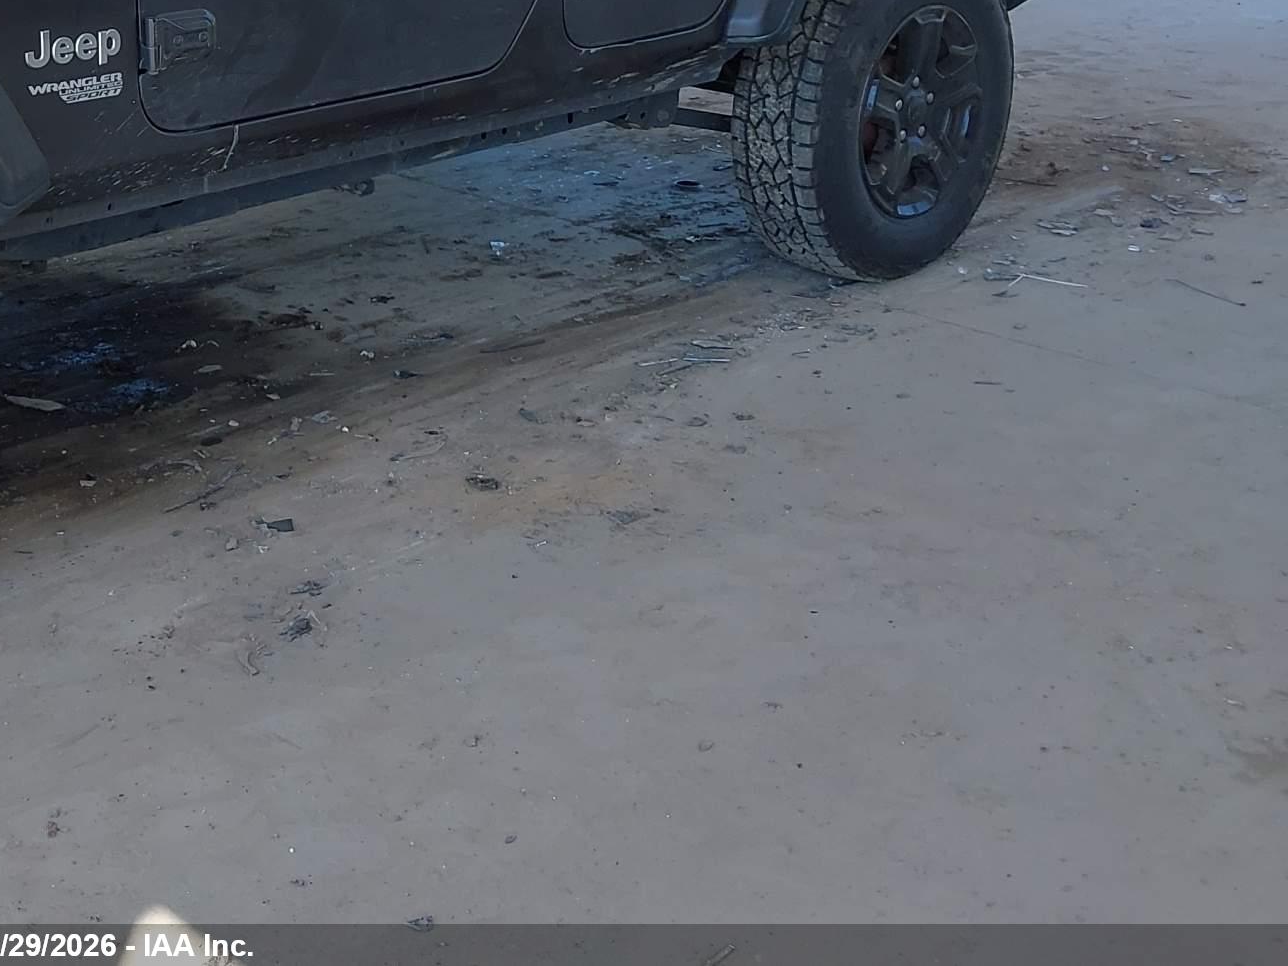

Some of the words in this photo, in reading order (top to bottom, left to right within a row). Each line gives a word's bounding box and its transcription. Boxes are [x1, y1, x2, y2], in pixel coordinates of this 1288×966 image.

[24, 28, 122, 69] Jeep
[27, 72, 123, 96] WRANGLER
[59, 80, 123, 96] UNLIMITED
[63, 87, 122, 102] SPORT
